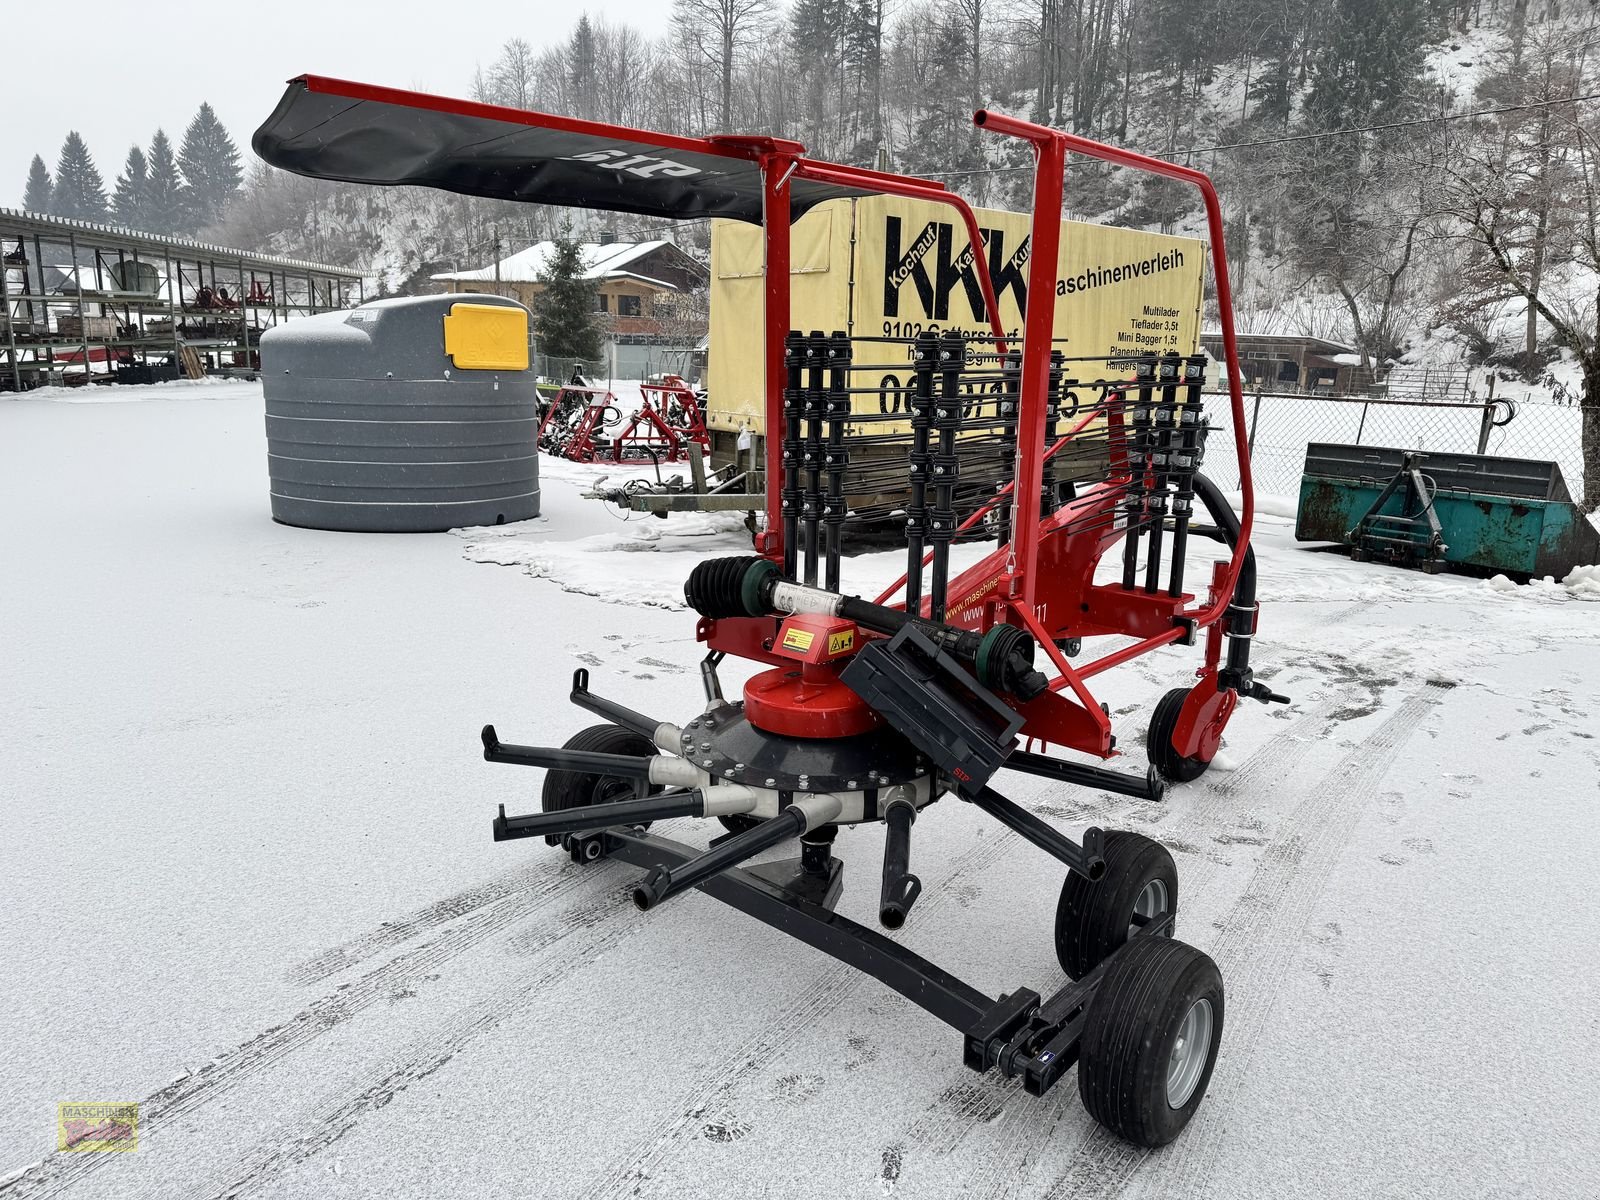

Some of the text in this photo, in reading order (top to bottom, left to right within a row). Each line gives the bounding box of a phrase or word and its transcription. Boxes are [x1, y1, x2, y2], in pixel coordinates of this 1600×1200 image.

[555, 149, 702, 179] SIP
[888, 224, 937, 289] Kochauf
[1056, 248, 1184, 296] aschinenverleih
[1143, 305, 1180, 317] Multilader
[883, 321, 922, 338] 9102
[1131, 319, 1179, 332] Tieflader 3,5t
[1117, 331, 1178, 346] Mini Bagger 1,5t
[944, 576, 1000, 621] www.maschine
